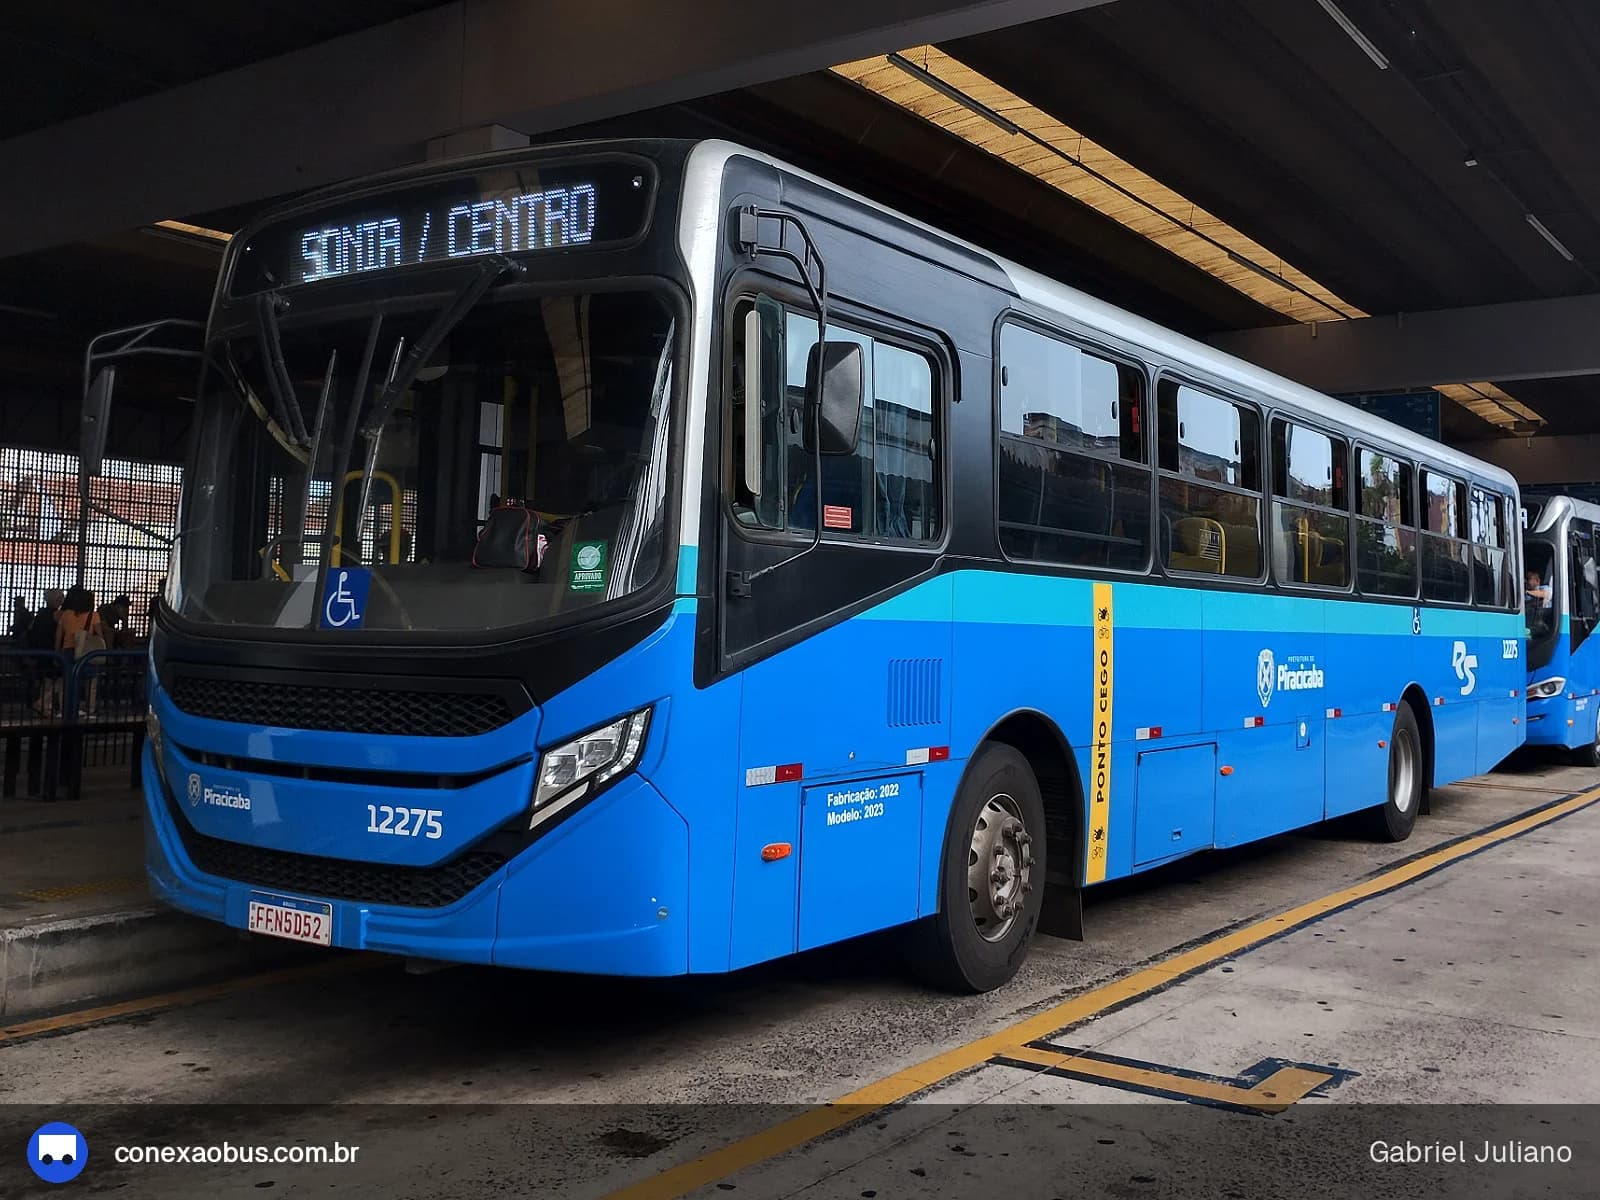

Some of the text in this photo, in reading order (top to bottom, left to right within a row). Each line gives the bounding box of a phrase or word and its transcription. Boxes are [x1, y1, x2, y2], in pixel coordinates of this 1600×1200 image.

[302, 184, 595, 282] SONIA / CENTRO
[1502, 639, 1518, 659] 12275
[1277, 664, 1324, 691] Piracicaba
[1096, 650, 1108, 803] PONTO CEGO
[204, 788, 251, 810] Piracicaba
[827, 783, 899, 807] Fabricação: 2022
[367, 804, 443, 839] 12275
[827, 803, 884, 826] Modelo: 2023
[256, 906, 322, 940] FFN5D52
